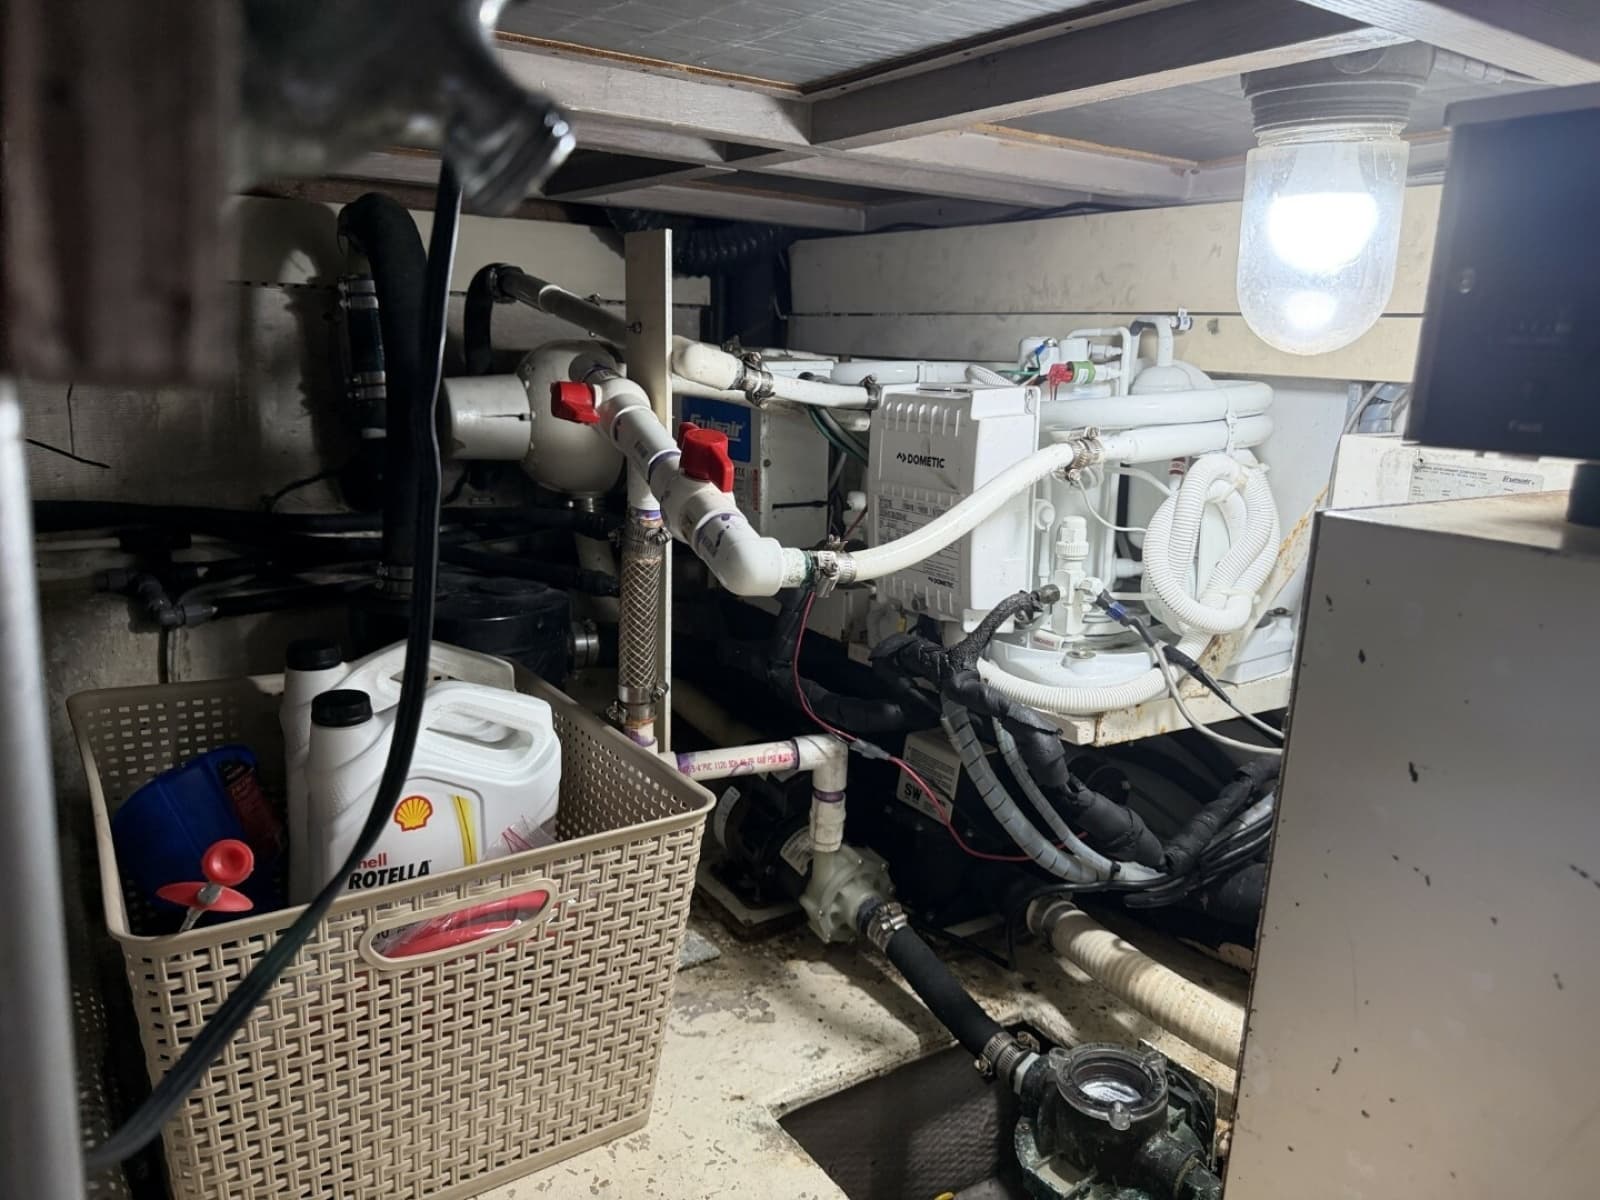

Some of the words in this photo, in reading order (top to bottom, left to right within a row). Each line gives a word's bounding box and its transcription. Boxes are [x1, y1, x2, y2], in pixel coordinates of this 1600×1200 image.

[907, 453, 945, 468] DOMETIC
[357, 852, 387, 869] hell
[348, 860, 431, 890] ROTELLA
